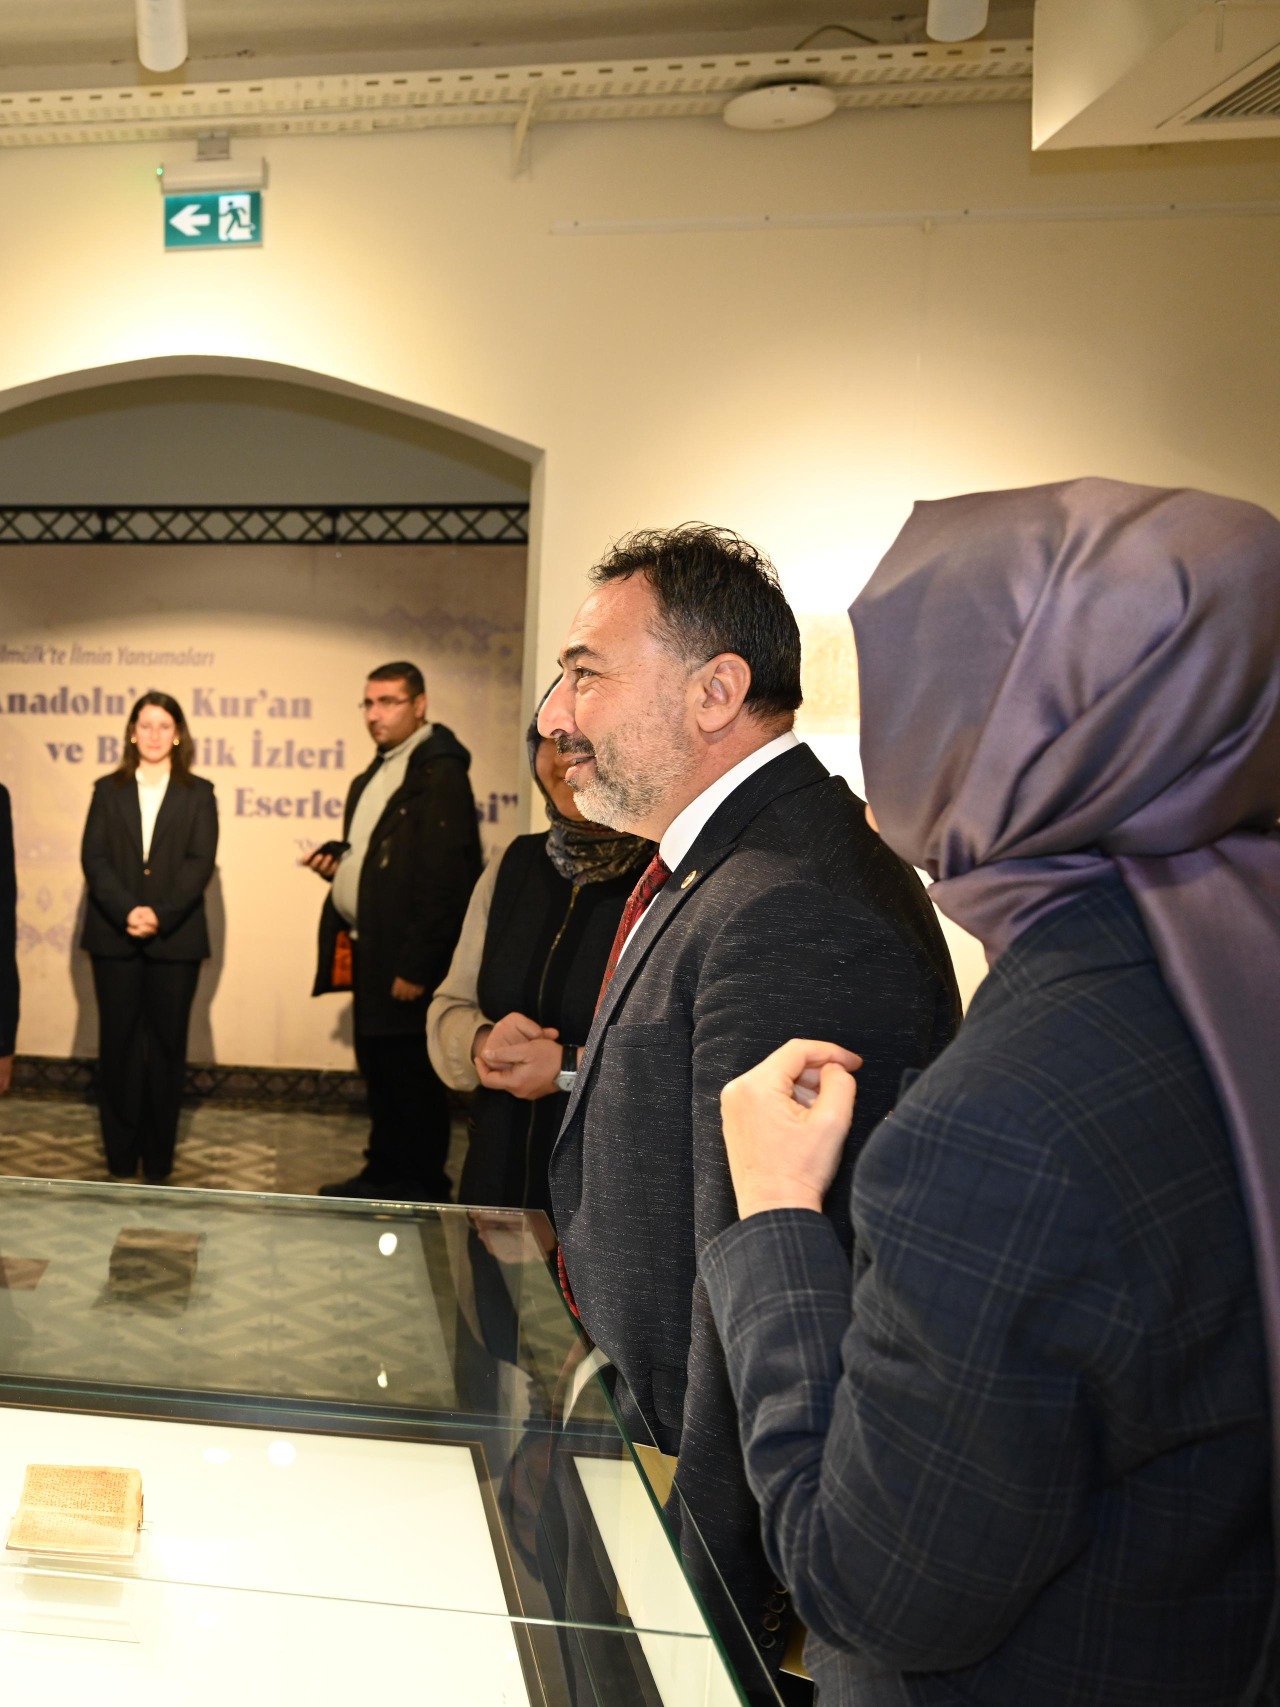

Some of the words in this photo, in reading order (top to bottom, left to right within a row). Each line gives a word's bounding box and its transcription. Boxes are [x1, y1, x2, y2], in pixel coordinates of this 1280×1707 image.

[70, 641, 113, 666] İlmin
[45, 741, 84, 764] ve
[252, 729, 345, 769] İzleri
[234, 787, 344, 820] Eserle
